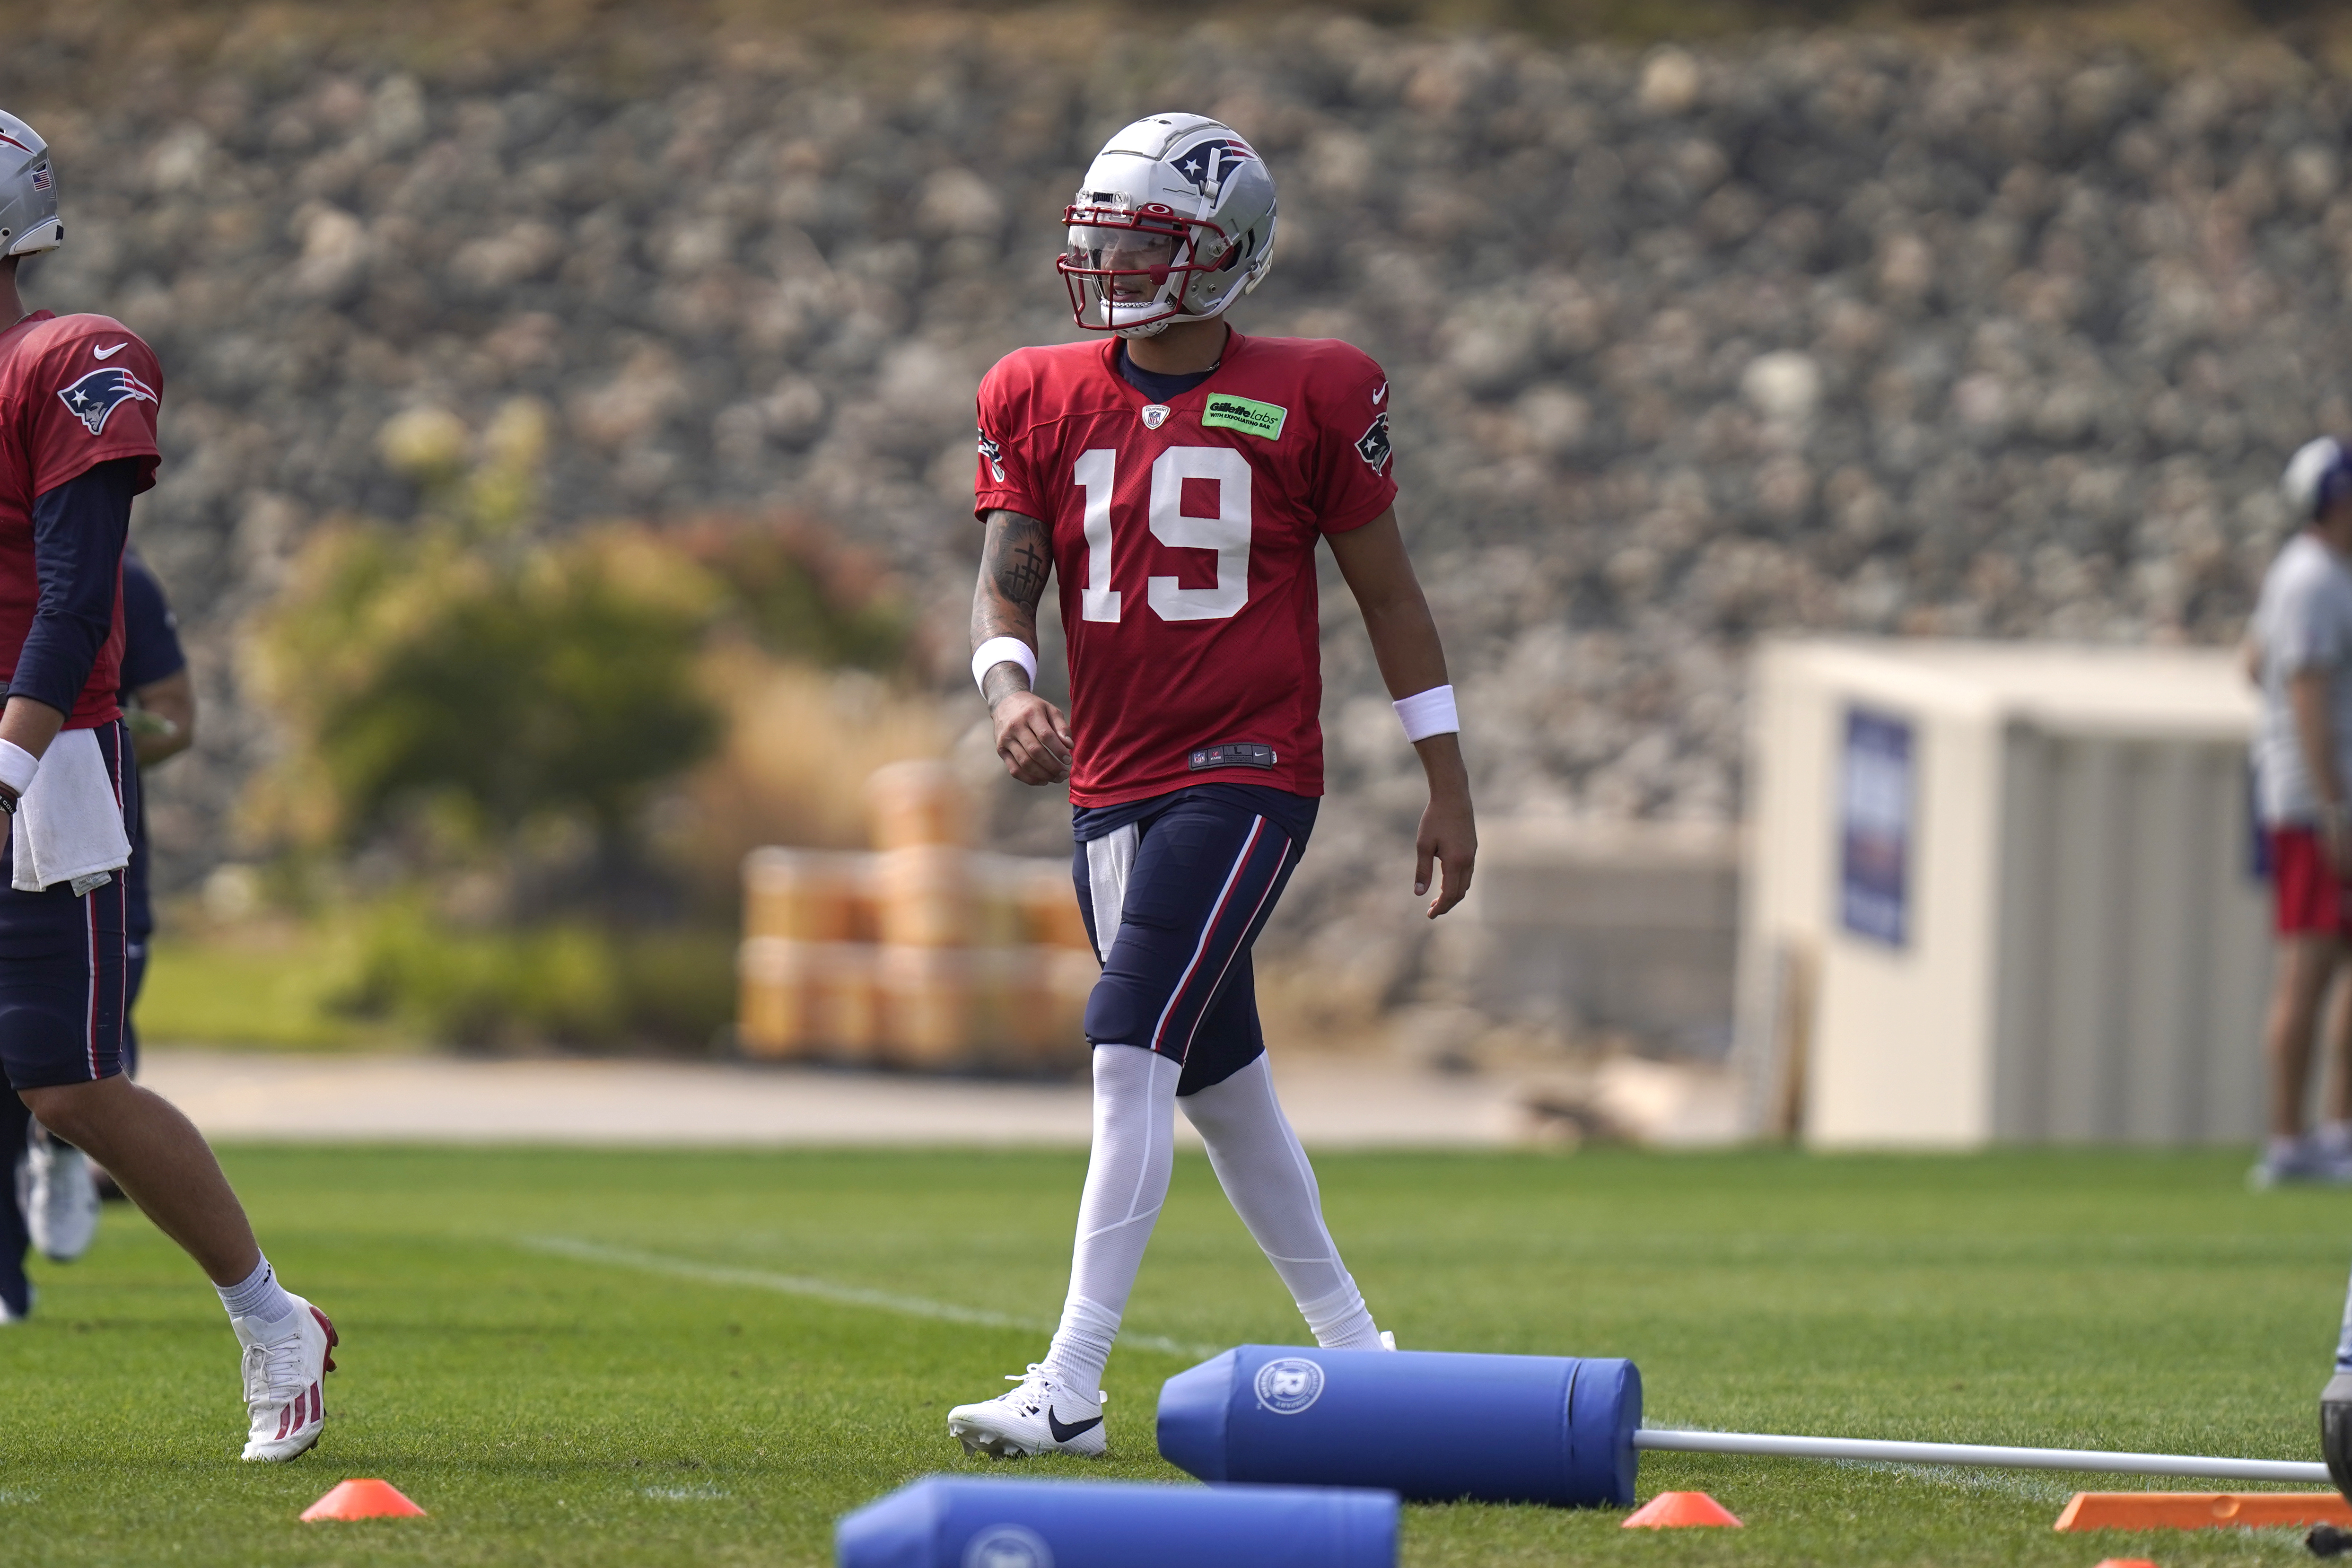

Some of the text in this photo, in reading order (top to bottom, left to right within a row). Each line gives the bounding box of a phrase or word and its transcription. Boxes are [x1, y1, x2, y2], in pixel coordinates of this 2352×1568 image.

[1224, 414, 1258, 426] EXFOLIATING
[1074, 446, 1252, 623] 19
[1234, 746, 1242, 754] L
